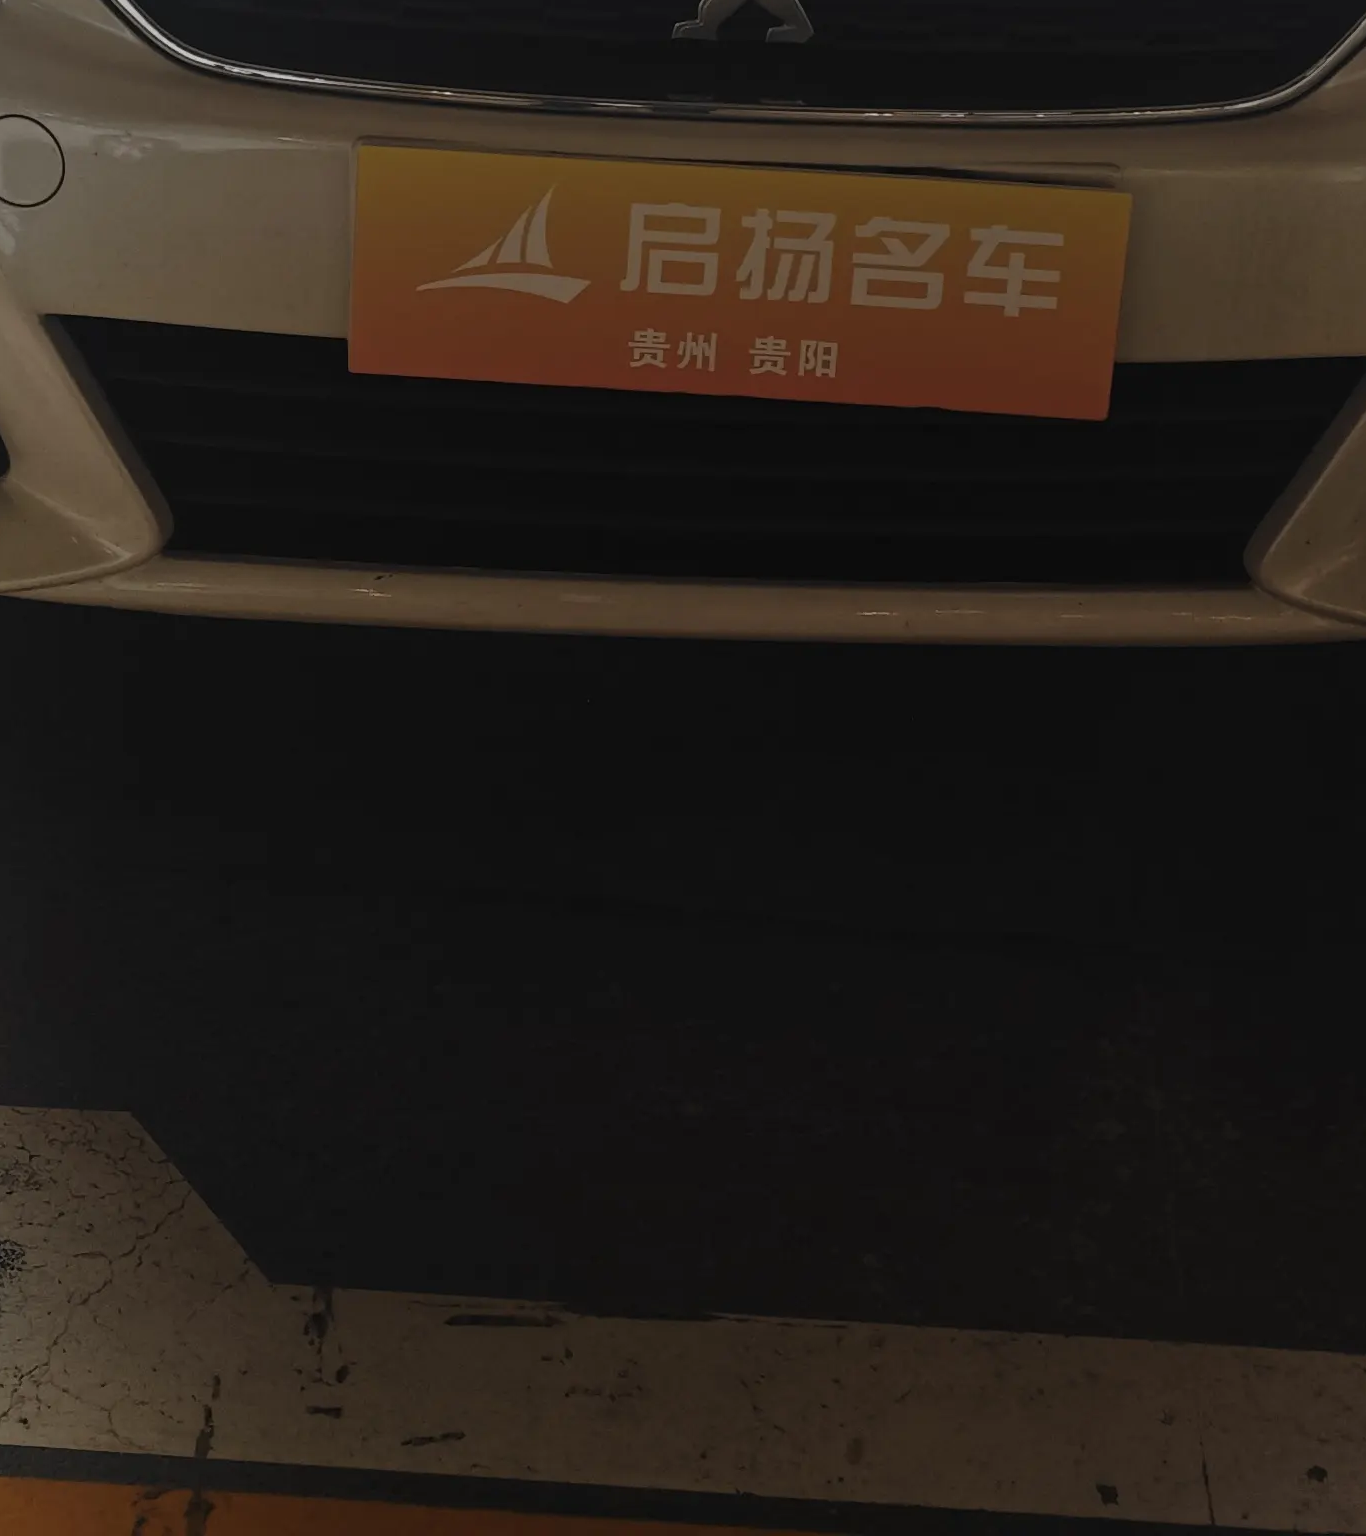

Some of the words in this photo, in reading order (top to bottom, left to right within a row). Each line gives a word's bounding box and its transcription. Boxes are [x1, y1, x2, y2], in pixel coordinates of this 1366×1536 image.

[619, 202, 1065, 317] 启扬名车
[628, 327, 718, 372] 贵州
[748, 335, 839, 378] 贵阳
